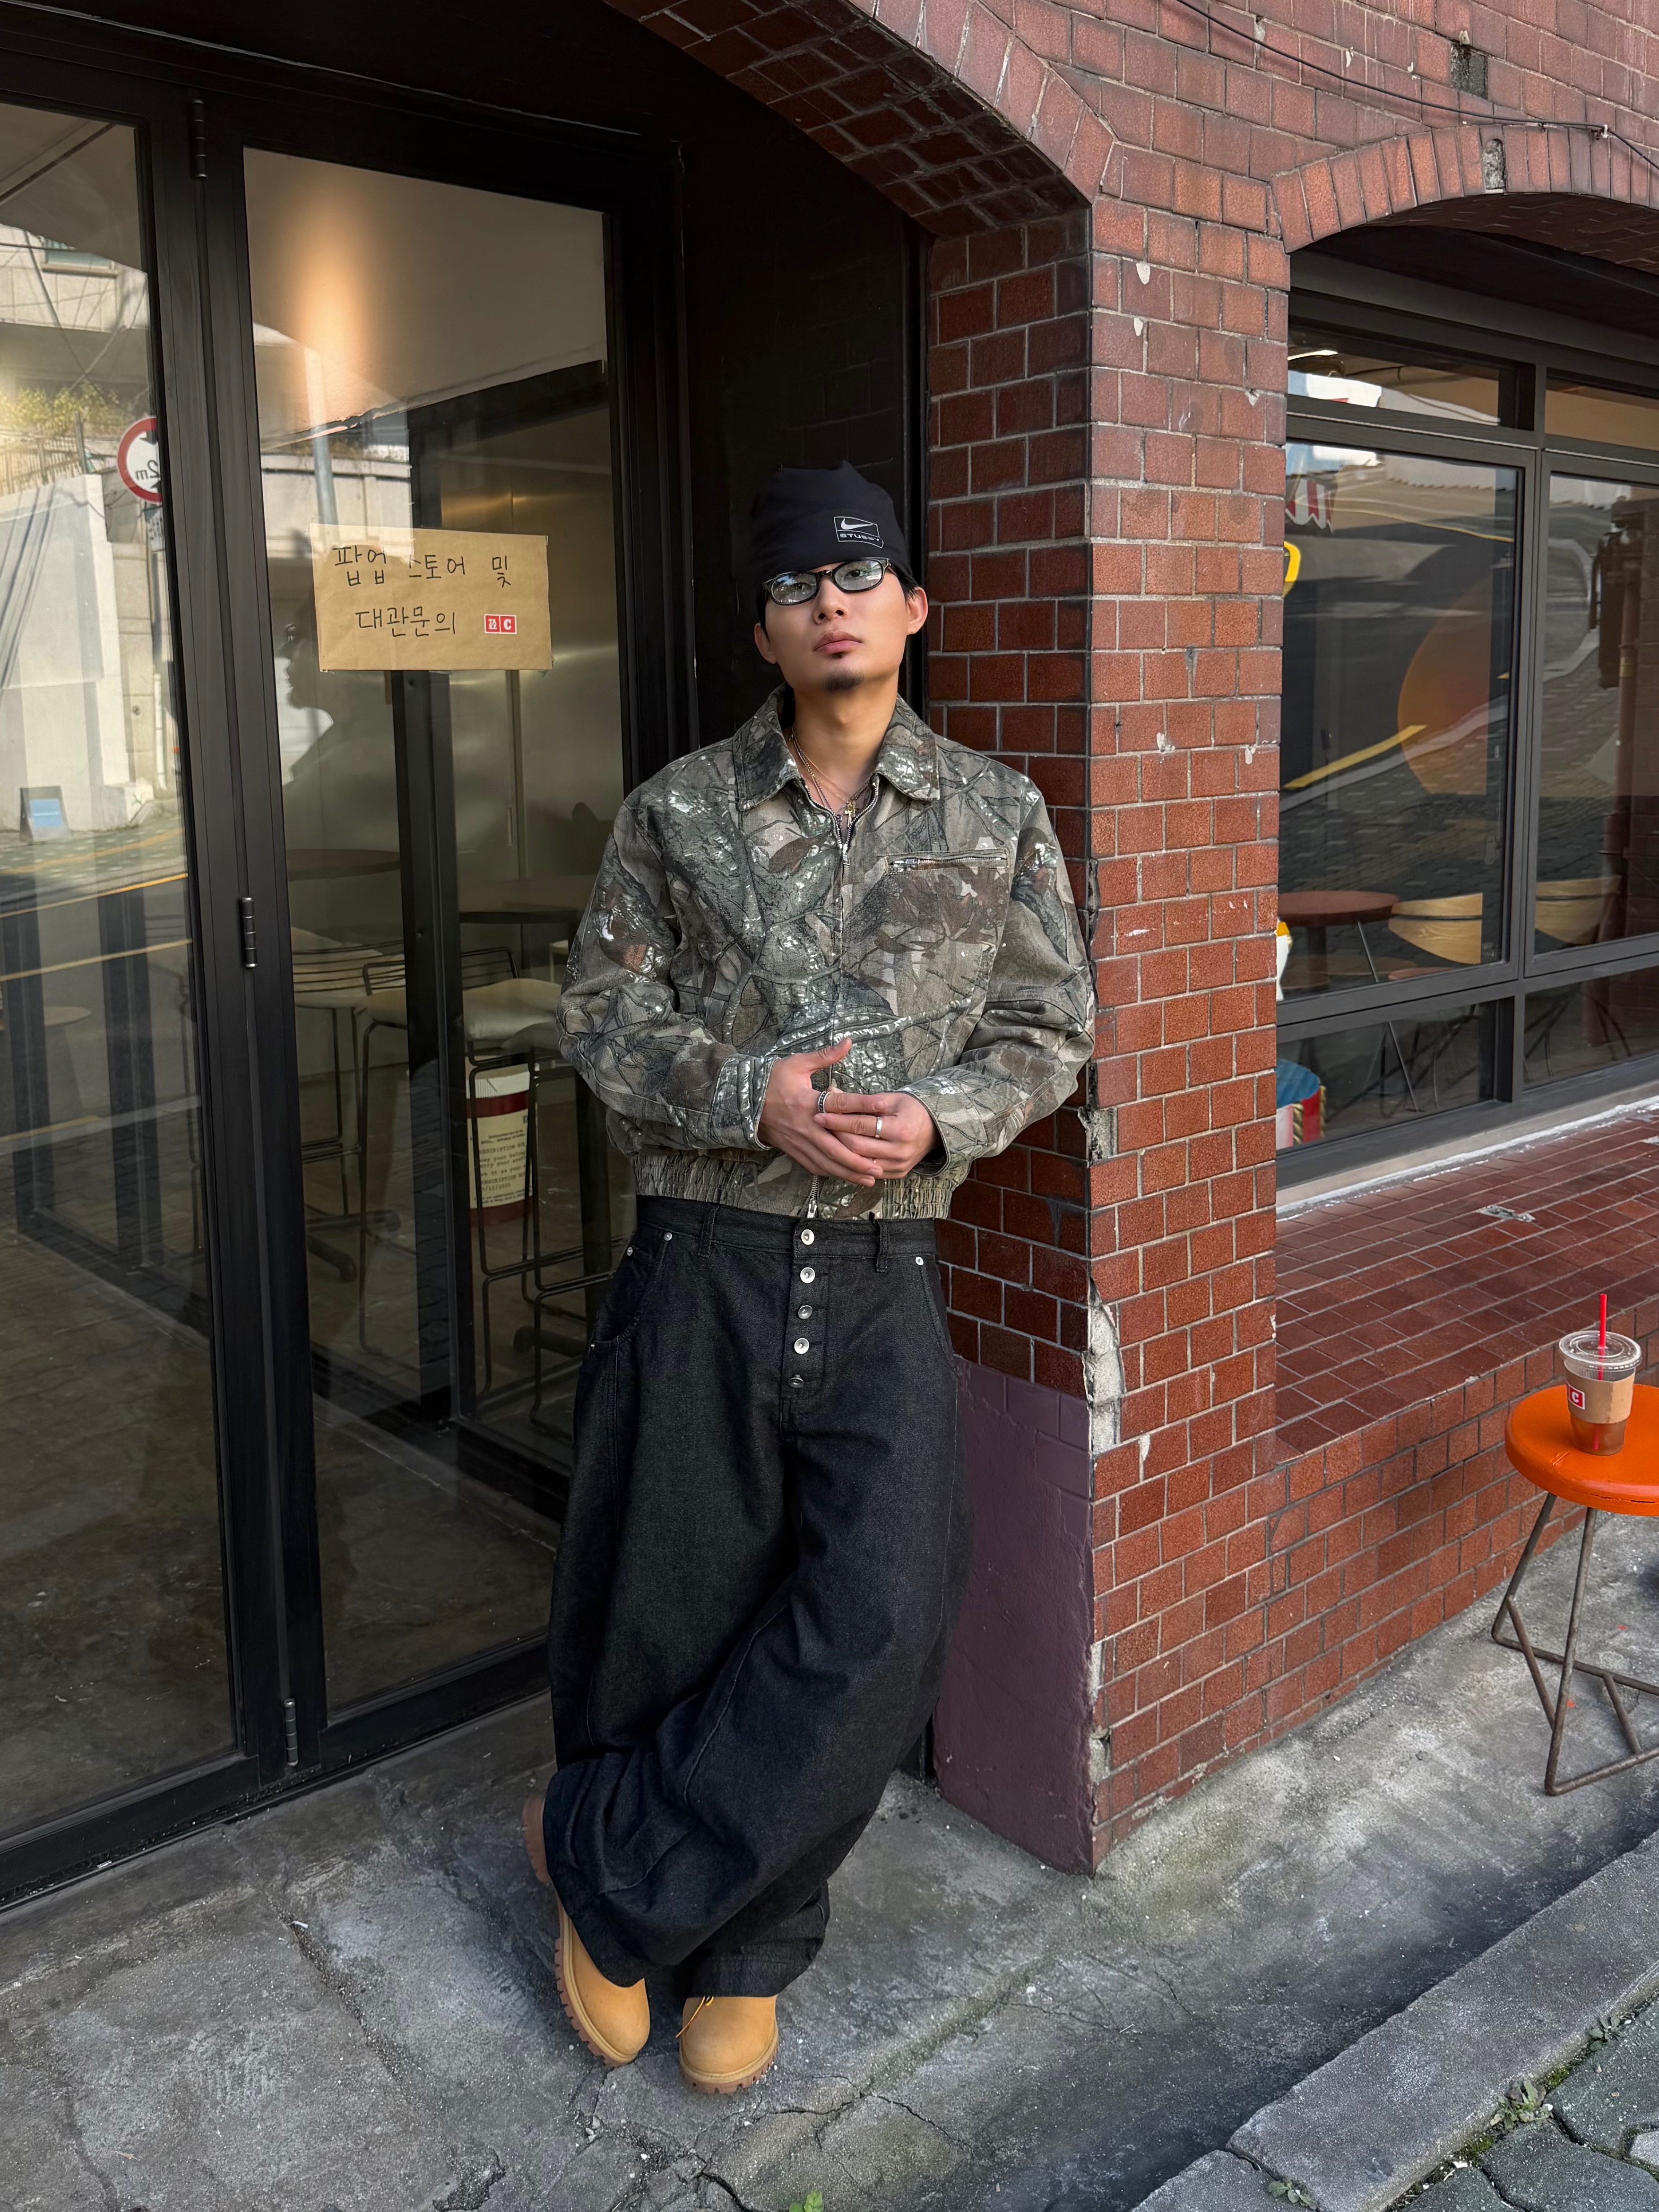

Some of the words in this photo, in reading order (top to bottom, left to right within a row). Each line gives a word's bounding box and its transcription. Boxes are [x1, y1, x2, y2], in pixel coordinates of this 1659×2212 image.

[332, 545, 386, 586] 팝업
[408, 554, 465, 579] 스토어
[492, 555, 511, 588] 및
[355, 606, 455, 637] 대관문의
[1572, 1391, 1579, 1403] C
